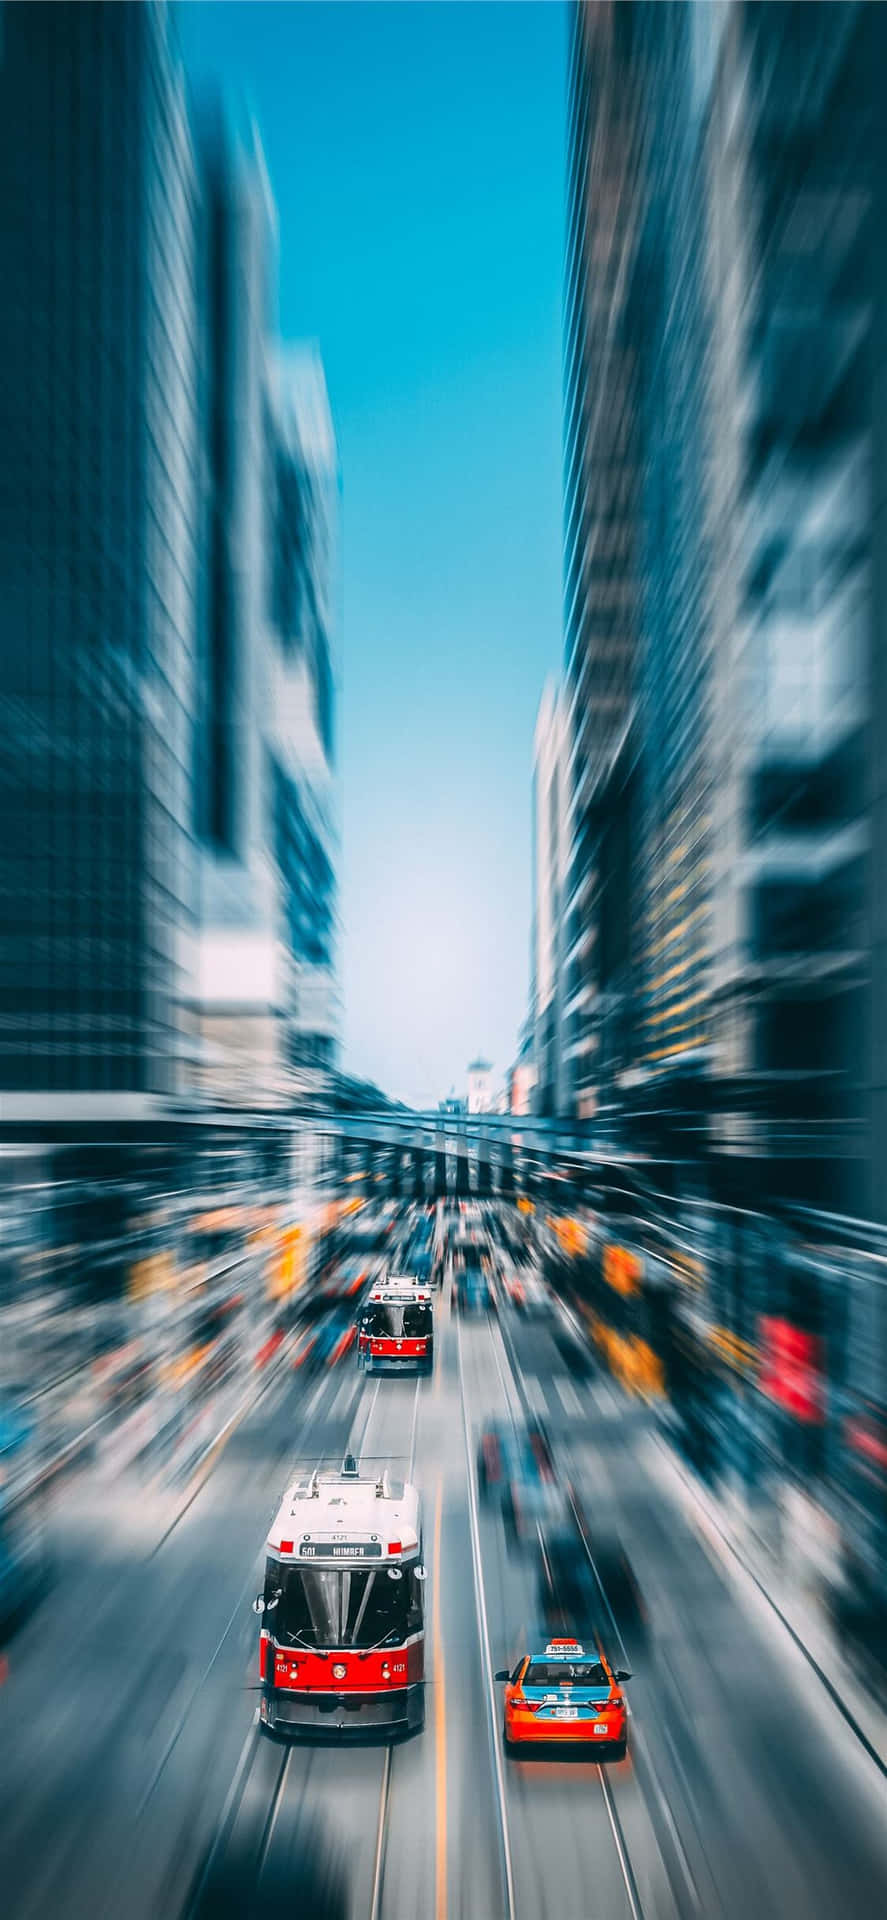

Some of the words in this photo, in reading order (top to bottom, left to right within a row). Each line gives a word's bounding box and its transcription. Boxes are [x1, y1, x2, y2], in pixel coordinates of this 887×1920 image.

[302, 1547, 315, 1556] 501
[333, 1547, 364, 1556] HUMBER
[276, 1664, 288, 1672] 4121
[393, 1664, 405, 1672] 4121
